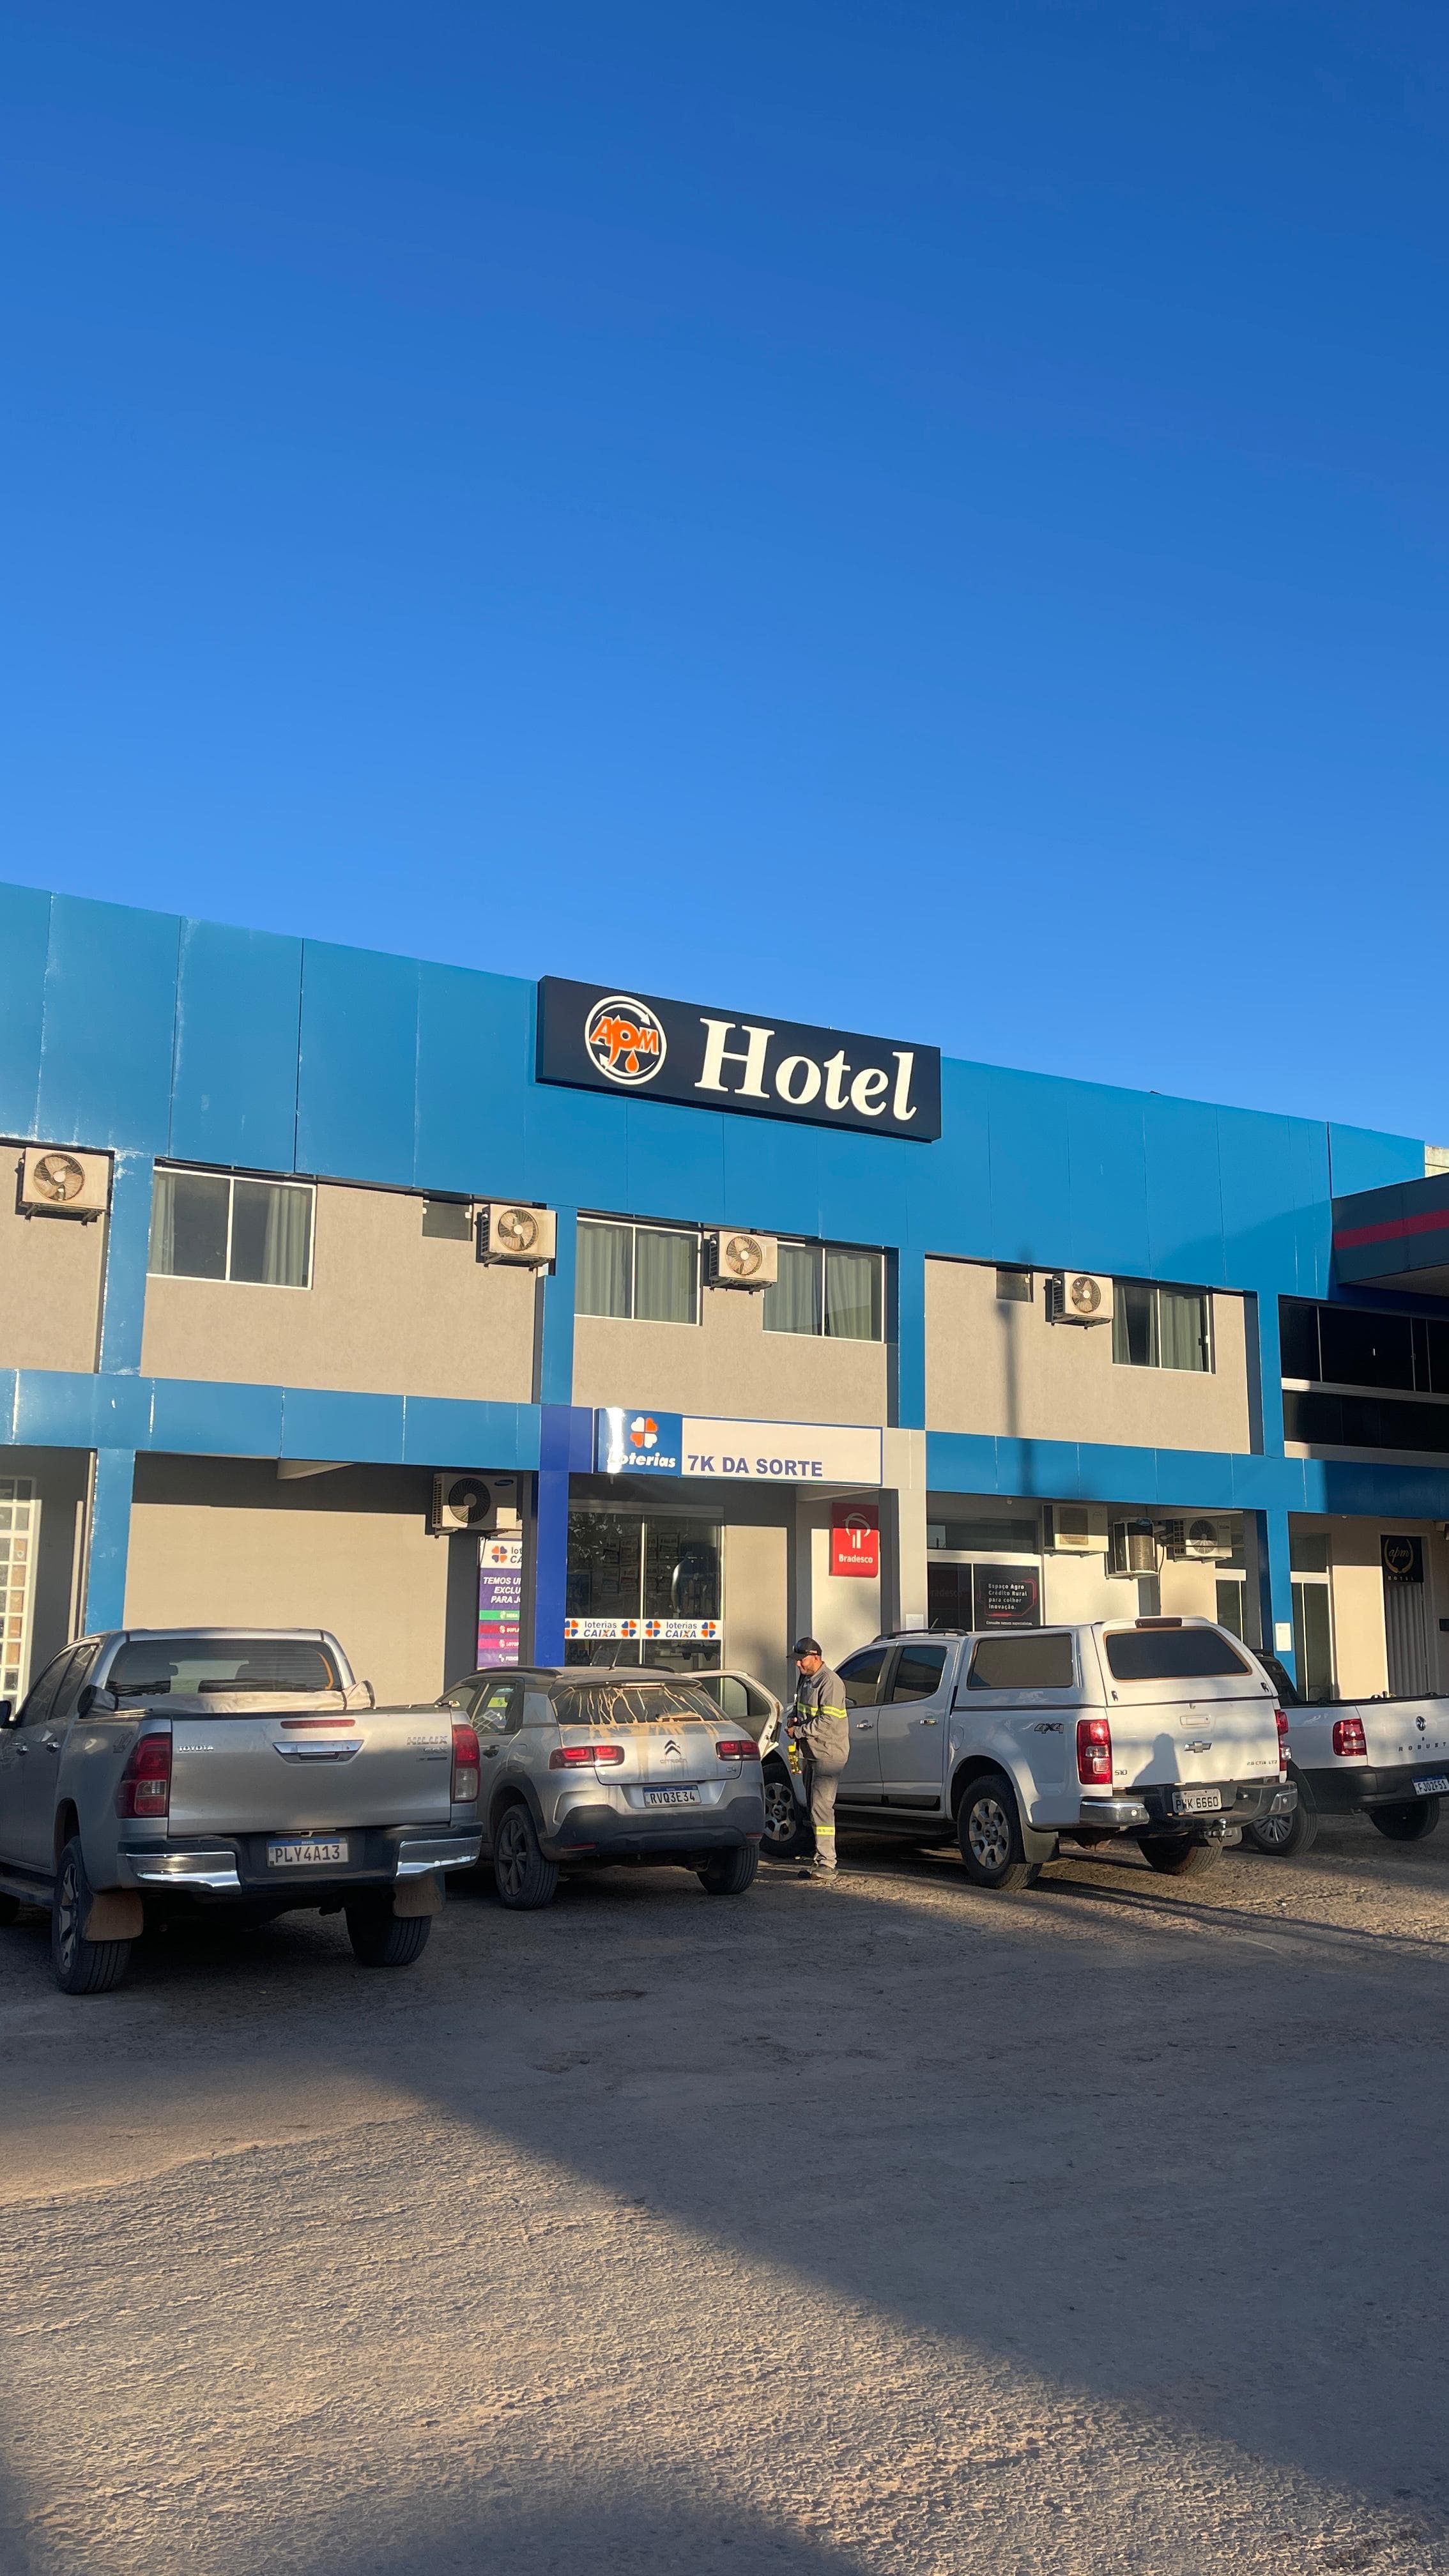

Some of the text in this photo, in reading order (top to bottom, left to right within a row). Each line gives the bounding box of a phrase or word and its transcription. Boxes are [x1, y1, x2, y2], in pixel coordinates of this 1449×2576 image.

[589, 1015, 659, 1066] APM
[694, 1018, 917, 1121] Hotel
[687, 1455, 823, 1477] 7K DA SORTE
[838, 1553, 873, 1564] Bradesco
[490, 1595, 513, 1604] PARA
[666, 1621, 698, 1629] loterias
[583, 1629, 617, 1637] CAIXA
[665, 1630, 697, 1638] CAIXA
[407, 1736, 448, 1745] HILUX
[1399, 1742, 1446, 1752] ROBUST
[650, 1791, 696, 1804] RVQ3E34
[1196, 1796, 1218, 1808] 6660
[275, 1845, 340, 1863] PLY4A13
